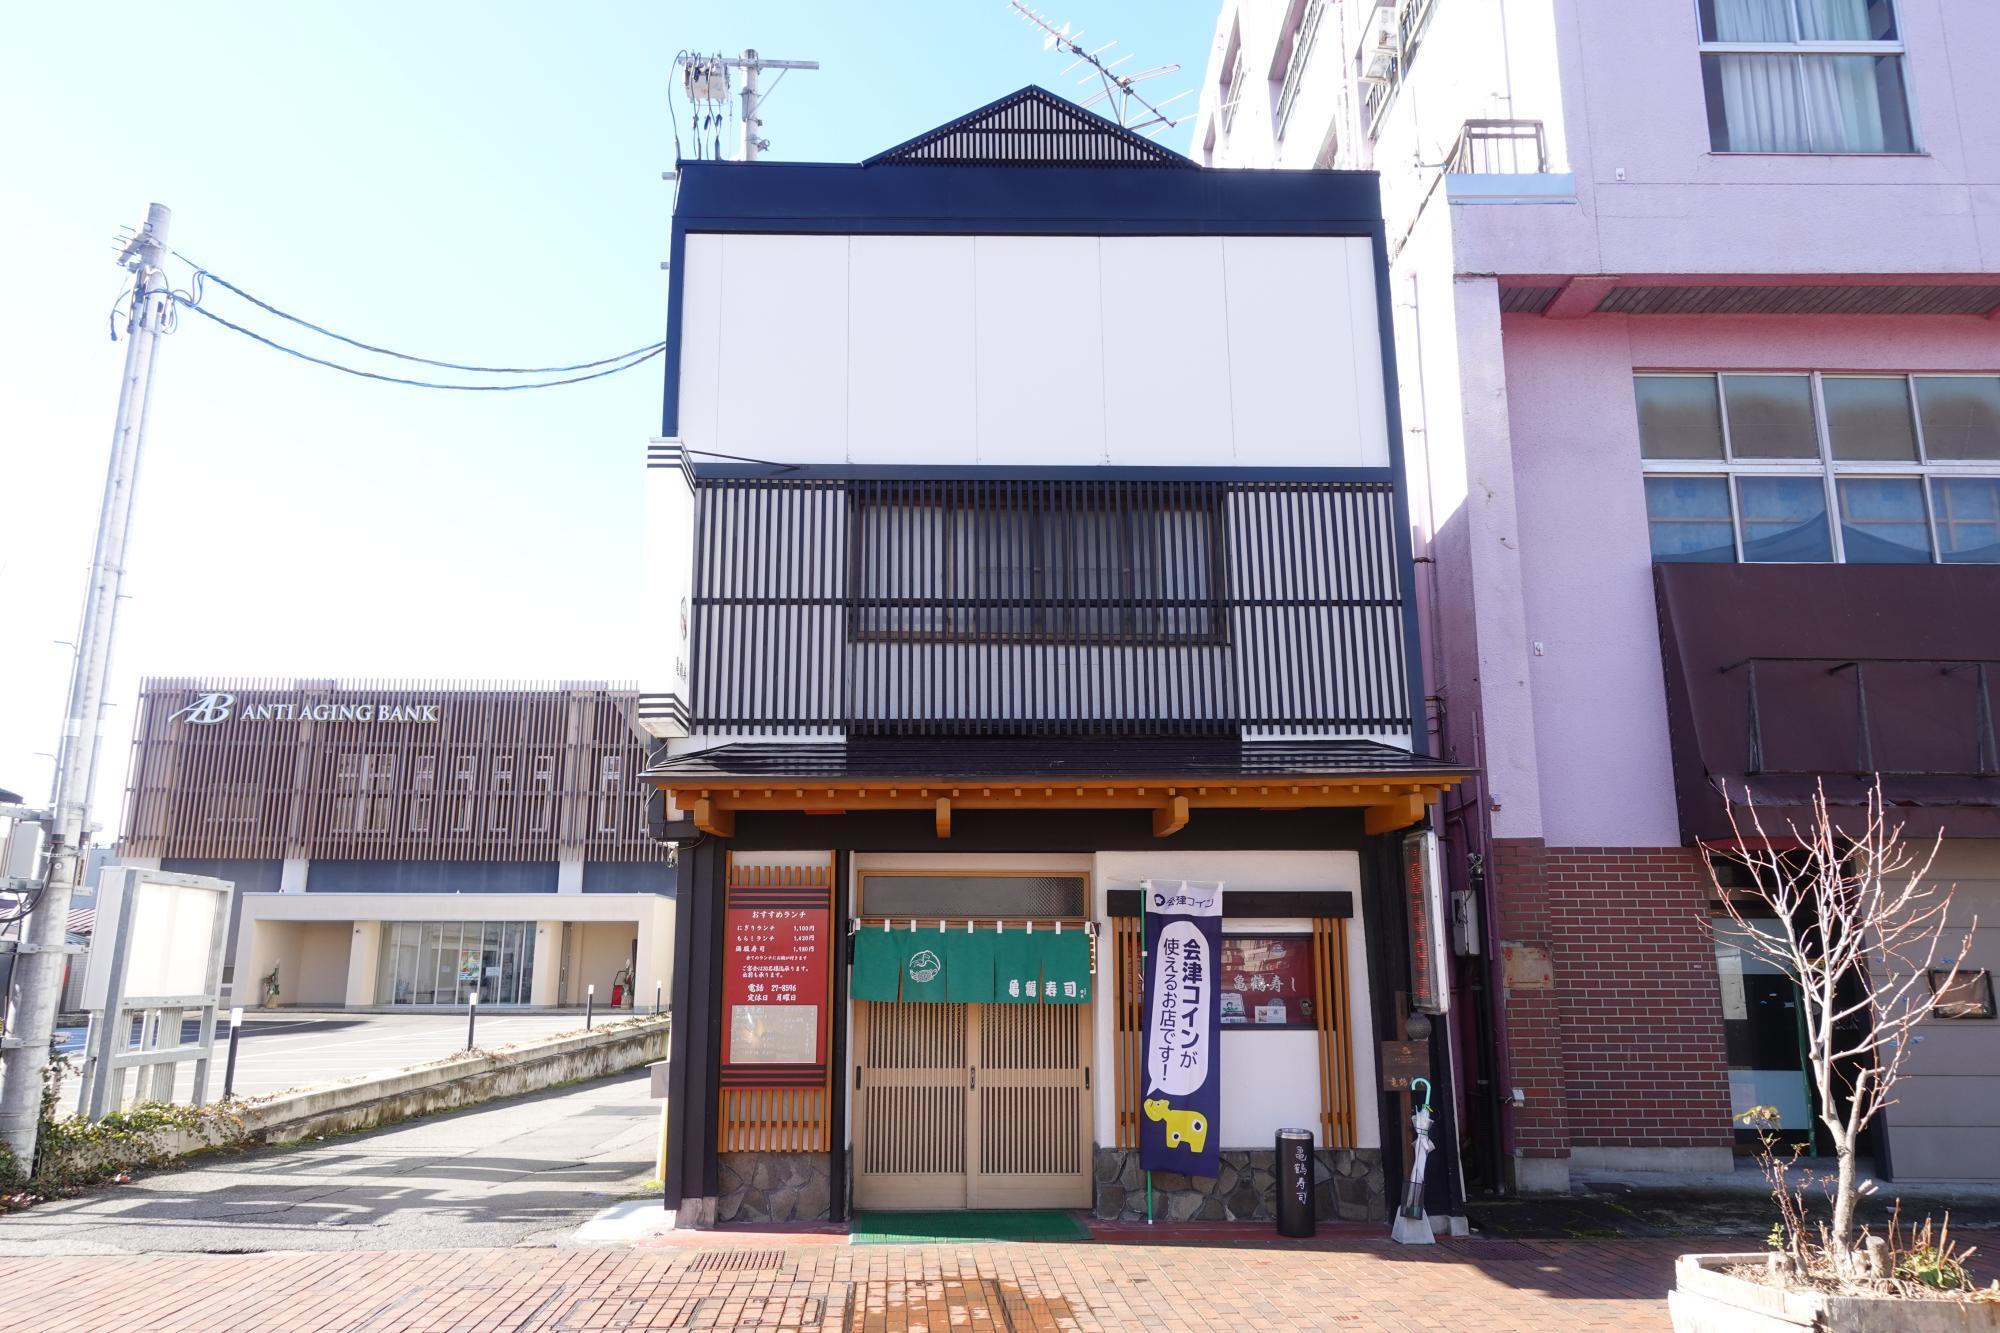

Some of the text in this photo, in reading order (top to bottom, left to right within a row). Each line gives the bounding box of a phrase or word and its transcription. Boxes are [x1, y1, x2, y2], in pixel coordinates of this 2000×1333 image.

[240, 703, 439, 724] ANTI AGING BANK
[1166, 895, 1214, 908] 会津コイン
[752, 911, 807, 919] おすすめランチ
[747, 983, 765, 992] 電話
[1008, 979, 1077, 998] 亀鶴寿司
[1233, 973, 1297, 993] 亀鶴寿し
[747, 994, 797, 1002] 定休日 月曜日
[1180, 938, 1203, 1069] 会津コインが
[1158, 938, 1180, 1081] 使えるお店です！
[1294, 1145, 1308, 1206] 亀鶴寿司
